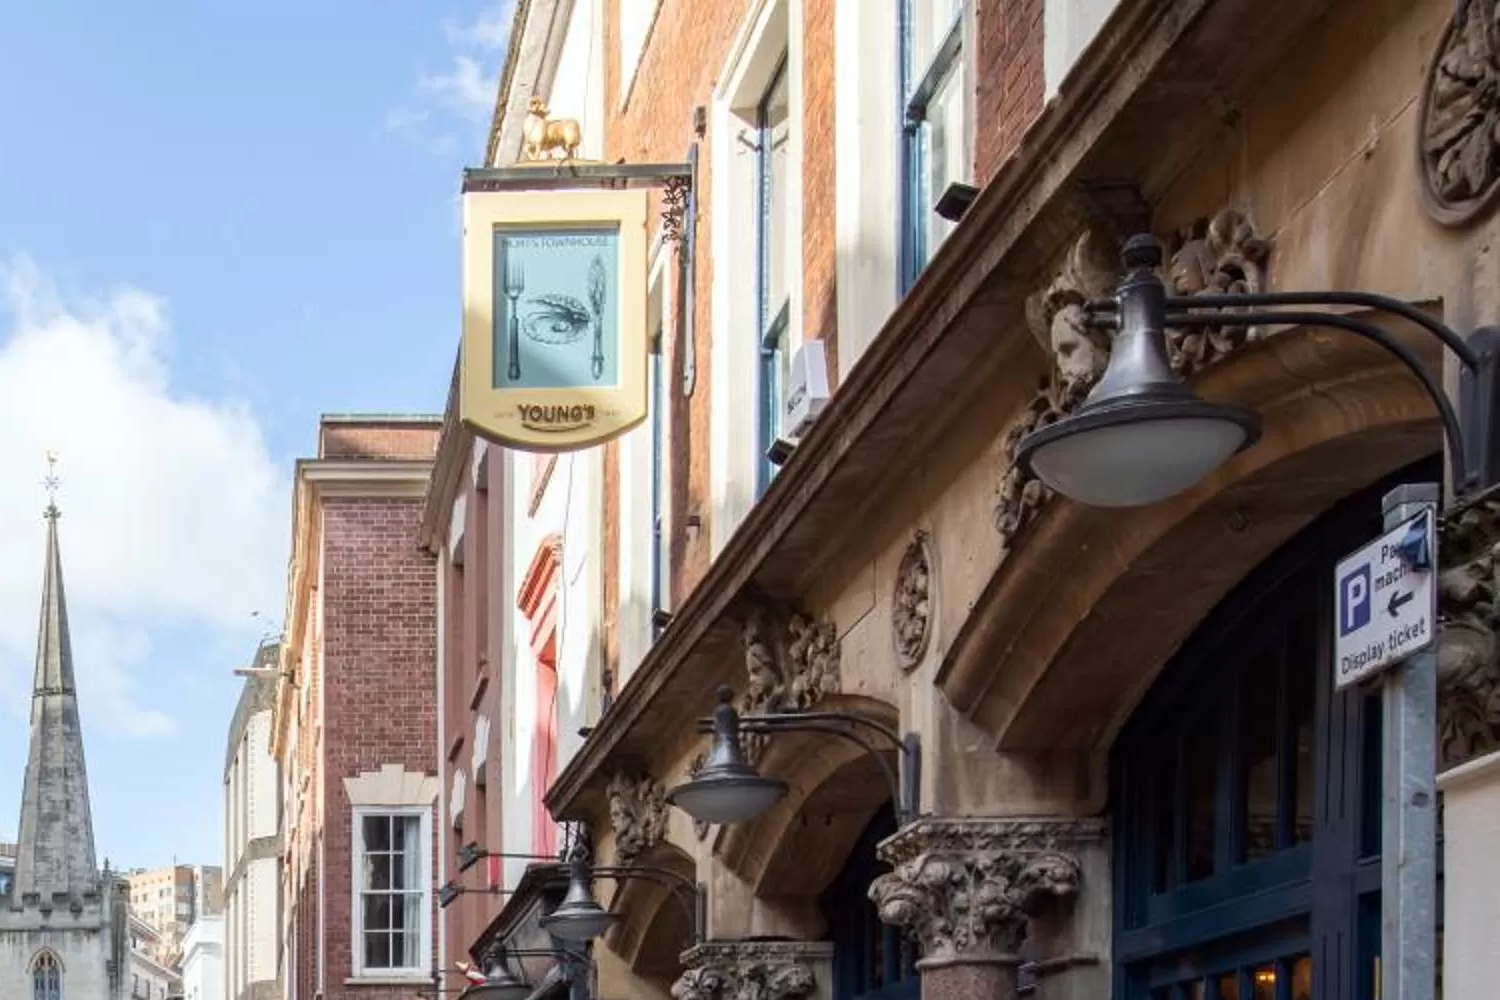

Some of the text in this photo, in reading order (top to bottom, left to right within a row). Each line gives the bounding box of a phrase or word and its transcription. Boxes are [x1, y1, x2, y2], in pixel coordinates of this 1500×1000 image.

[1347, 574, 1367, 629] P
[1341, 617, 1425, 675] Display ticket
